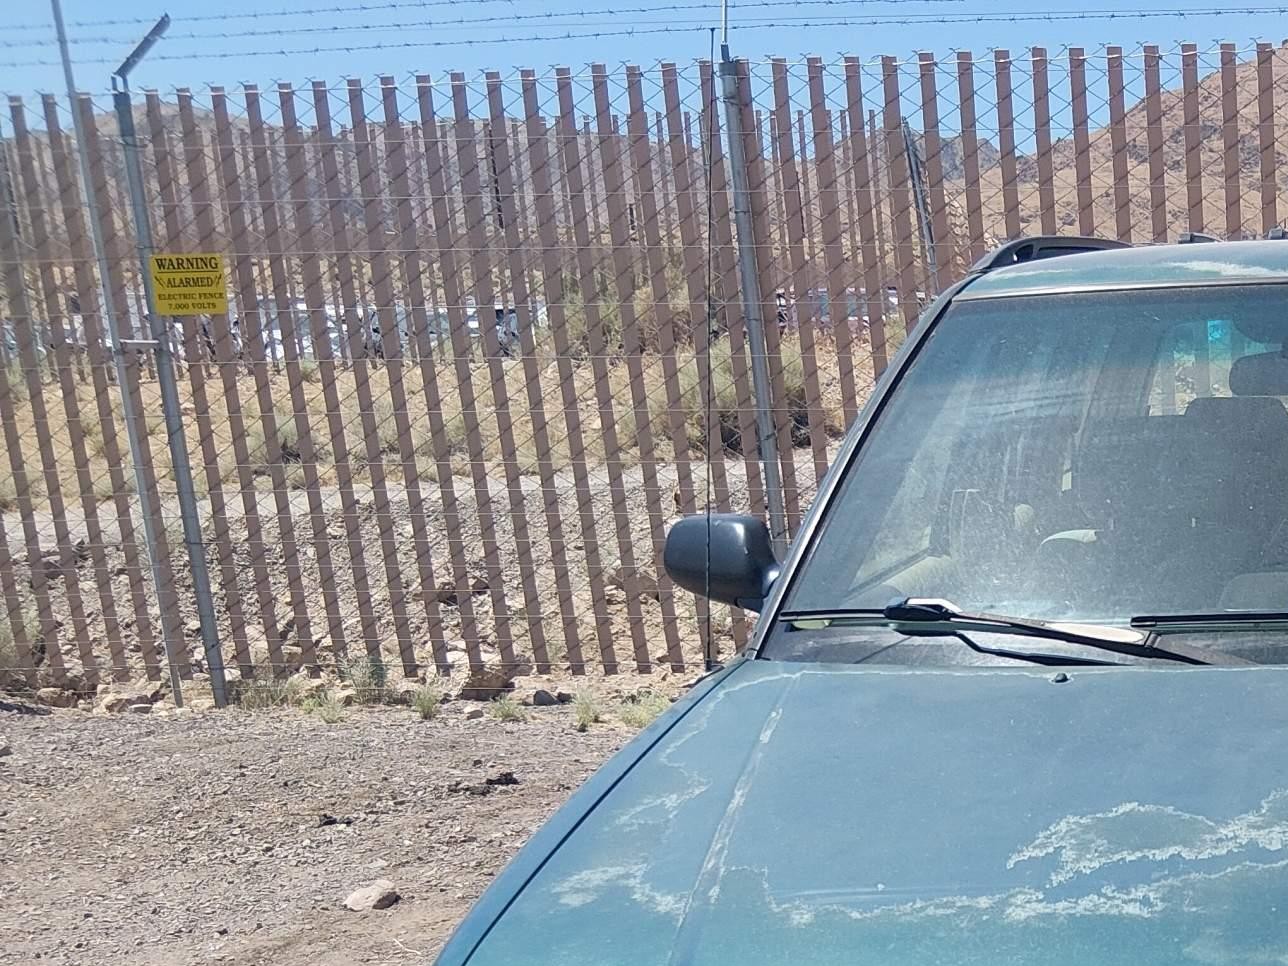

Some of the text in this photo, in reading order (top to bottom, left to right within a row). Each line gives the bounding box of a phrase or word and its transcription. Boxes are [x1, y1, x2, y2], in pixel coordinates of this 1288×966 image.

[155, 257, 218, 270] WARNING
[167, 277, 213, 288] ALARMED
[158, 292, 224, 301] ELECTRIC FENCE
